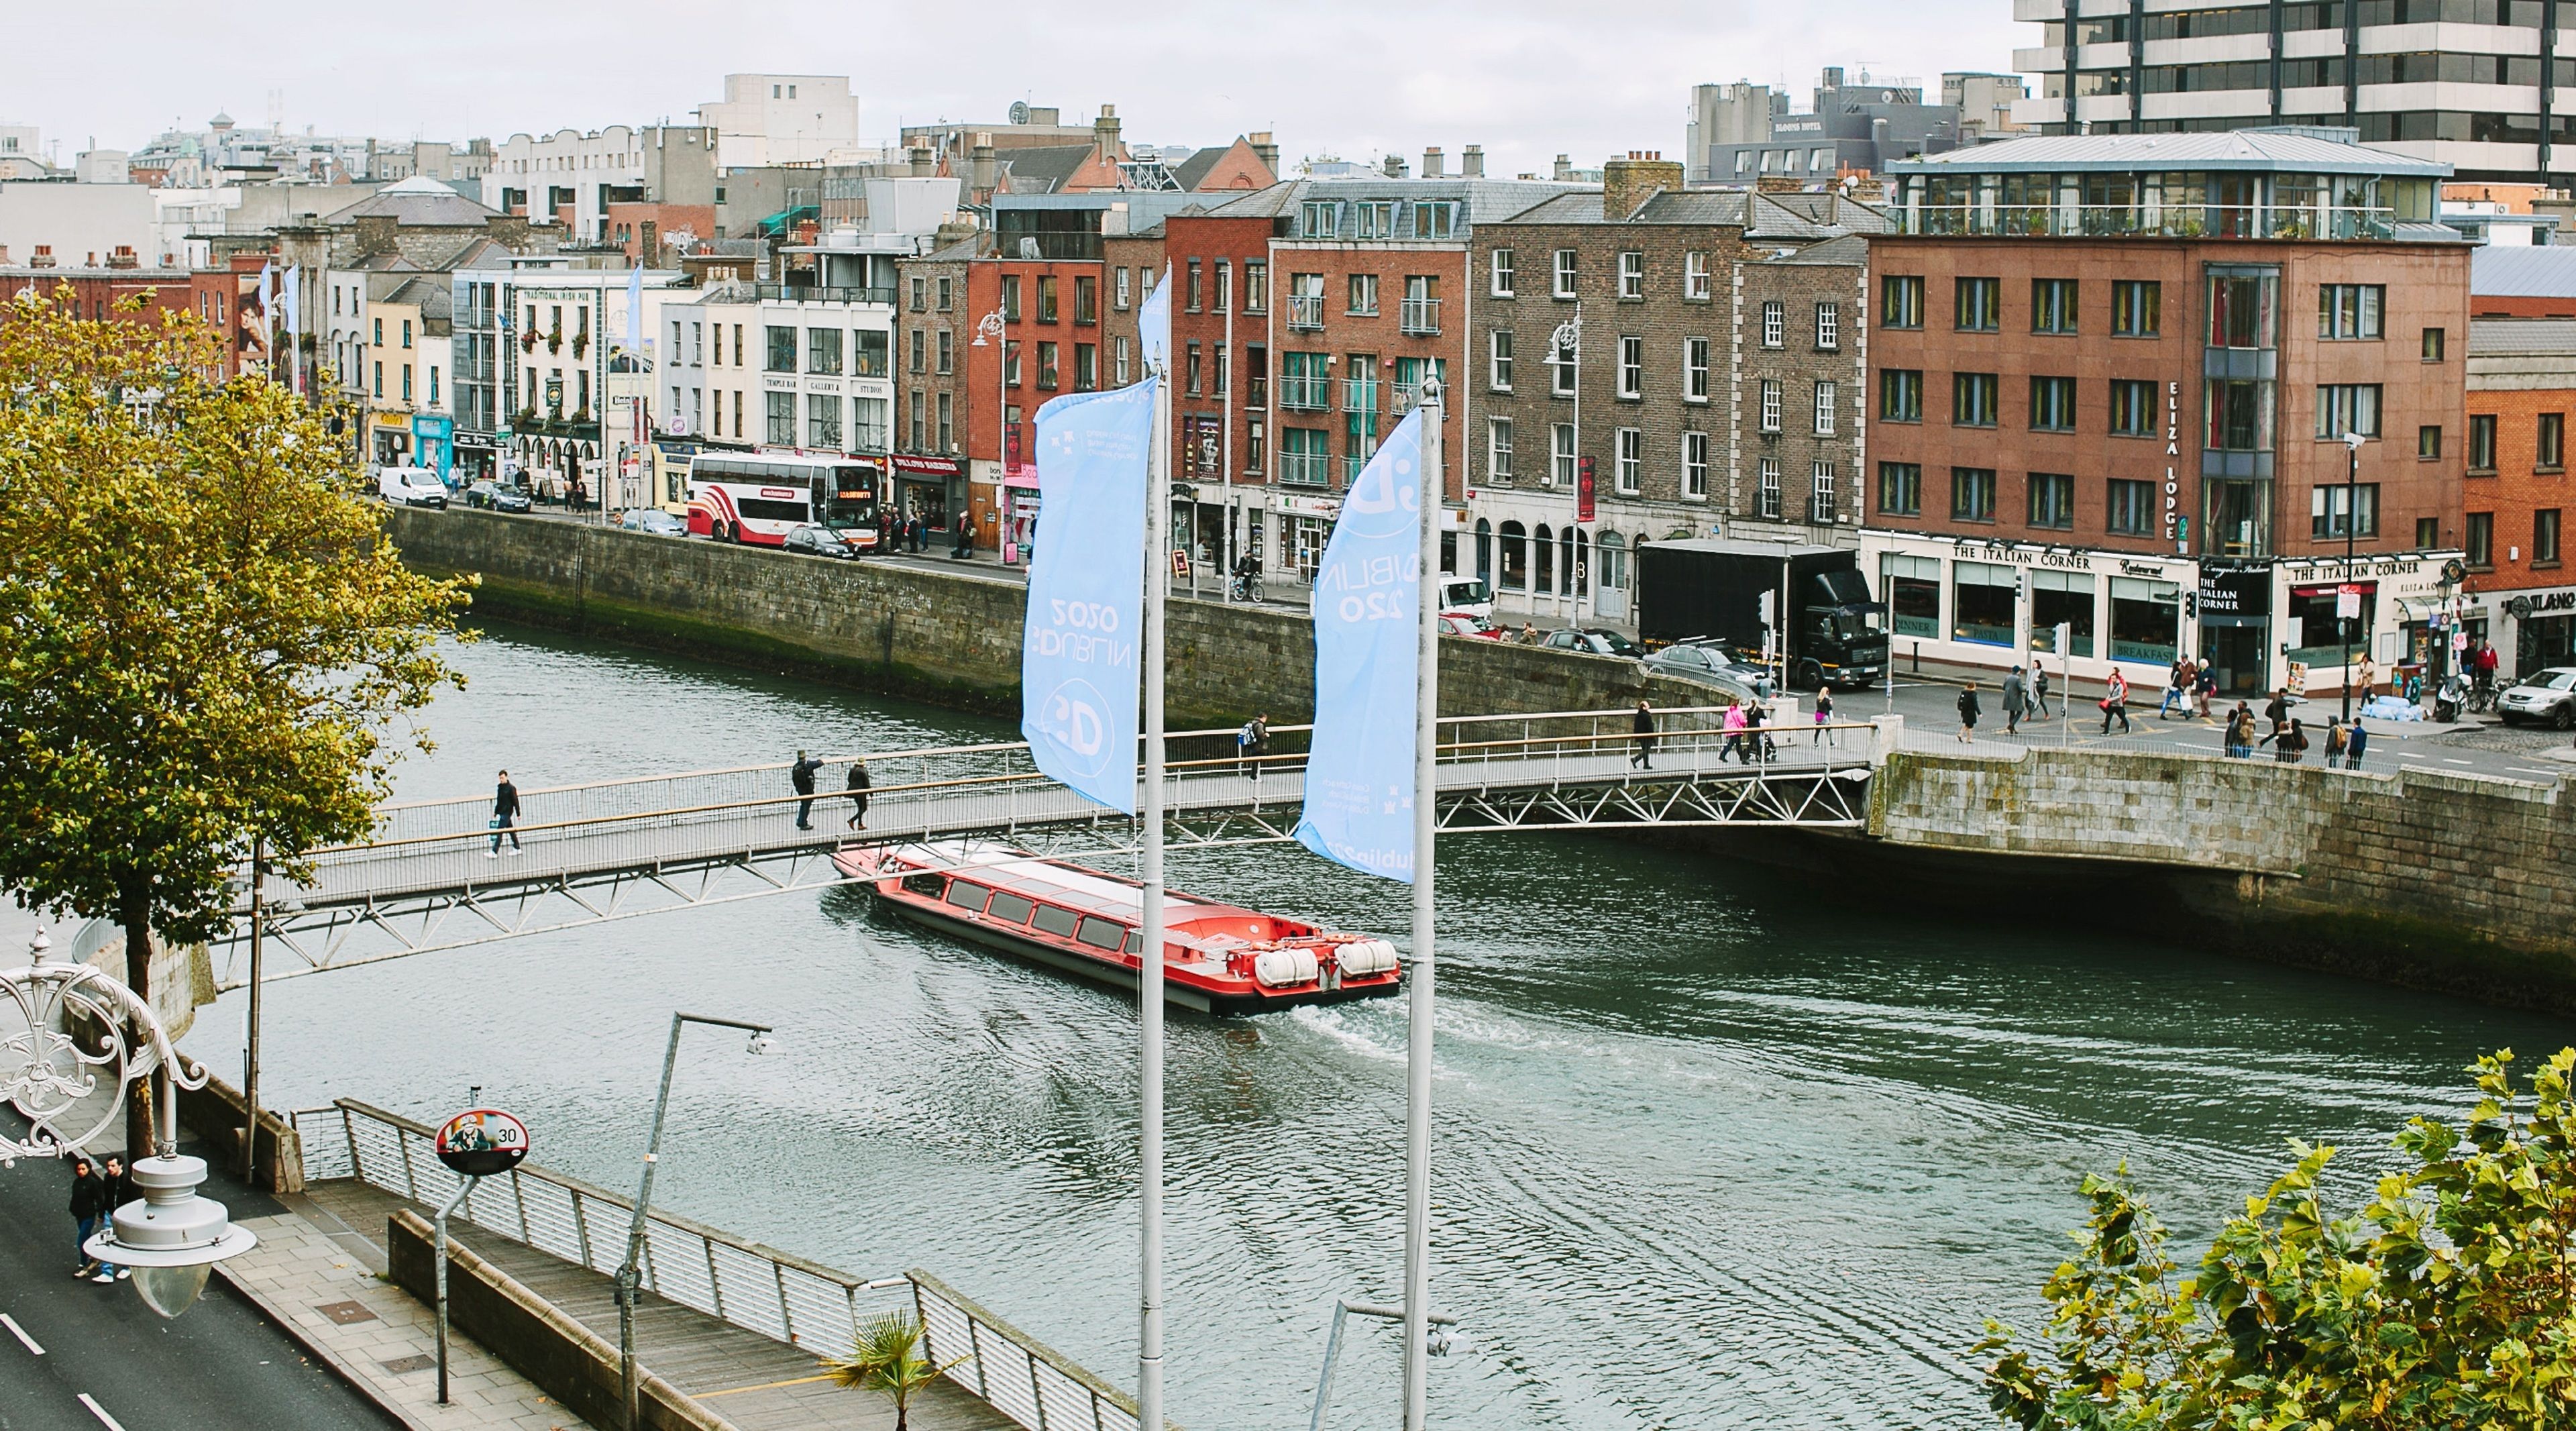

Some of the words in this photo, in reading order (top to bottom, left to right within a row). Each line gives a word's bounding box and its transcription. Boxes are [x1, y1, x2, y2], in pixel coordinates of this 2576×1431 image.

[524, 291, 557, 301] TRADITIONAL
[560, 292, 576, 301] IRISH
[578, 293, 589, 301] PUB
[767, 379, 785, 388] TEMPLE
[787, 380, 796, 388] BAR
[810, 382, 835, 391] GALLERY
[860, 386, 882, 394] STUDIOS
[2167, 382, 2178, 455] ELIZA
[2165, 467, 2178, 539] LODGE
[1953, 547, 1975, 558] THE
[1984, 550, 2032, 564] ITALIAN
[2041, 554, 2090, 570] CORNER
[2294, 569, 2314, 581] THE
[2323, 565, 2369, 579] ITALAN
[2376, 562, 2420, 576] CORNER
[2200, 578, 2216, 588] THE
[2401, 583, 2424, 592] ELIZA
[2200, 589, 2237, 599] ITALIAN
[2200, 599, 2239, 610] CORNER
[1973, 629, 1999, 641] PASTA
[2117, 645, 2175, 661] BREAKFAST
[498, 1128, 516, 1143] 30
